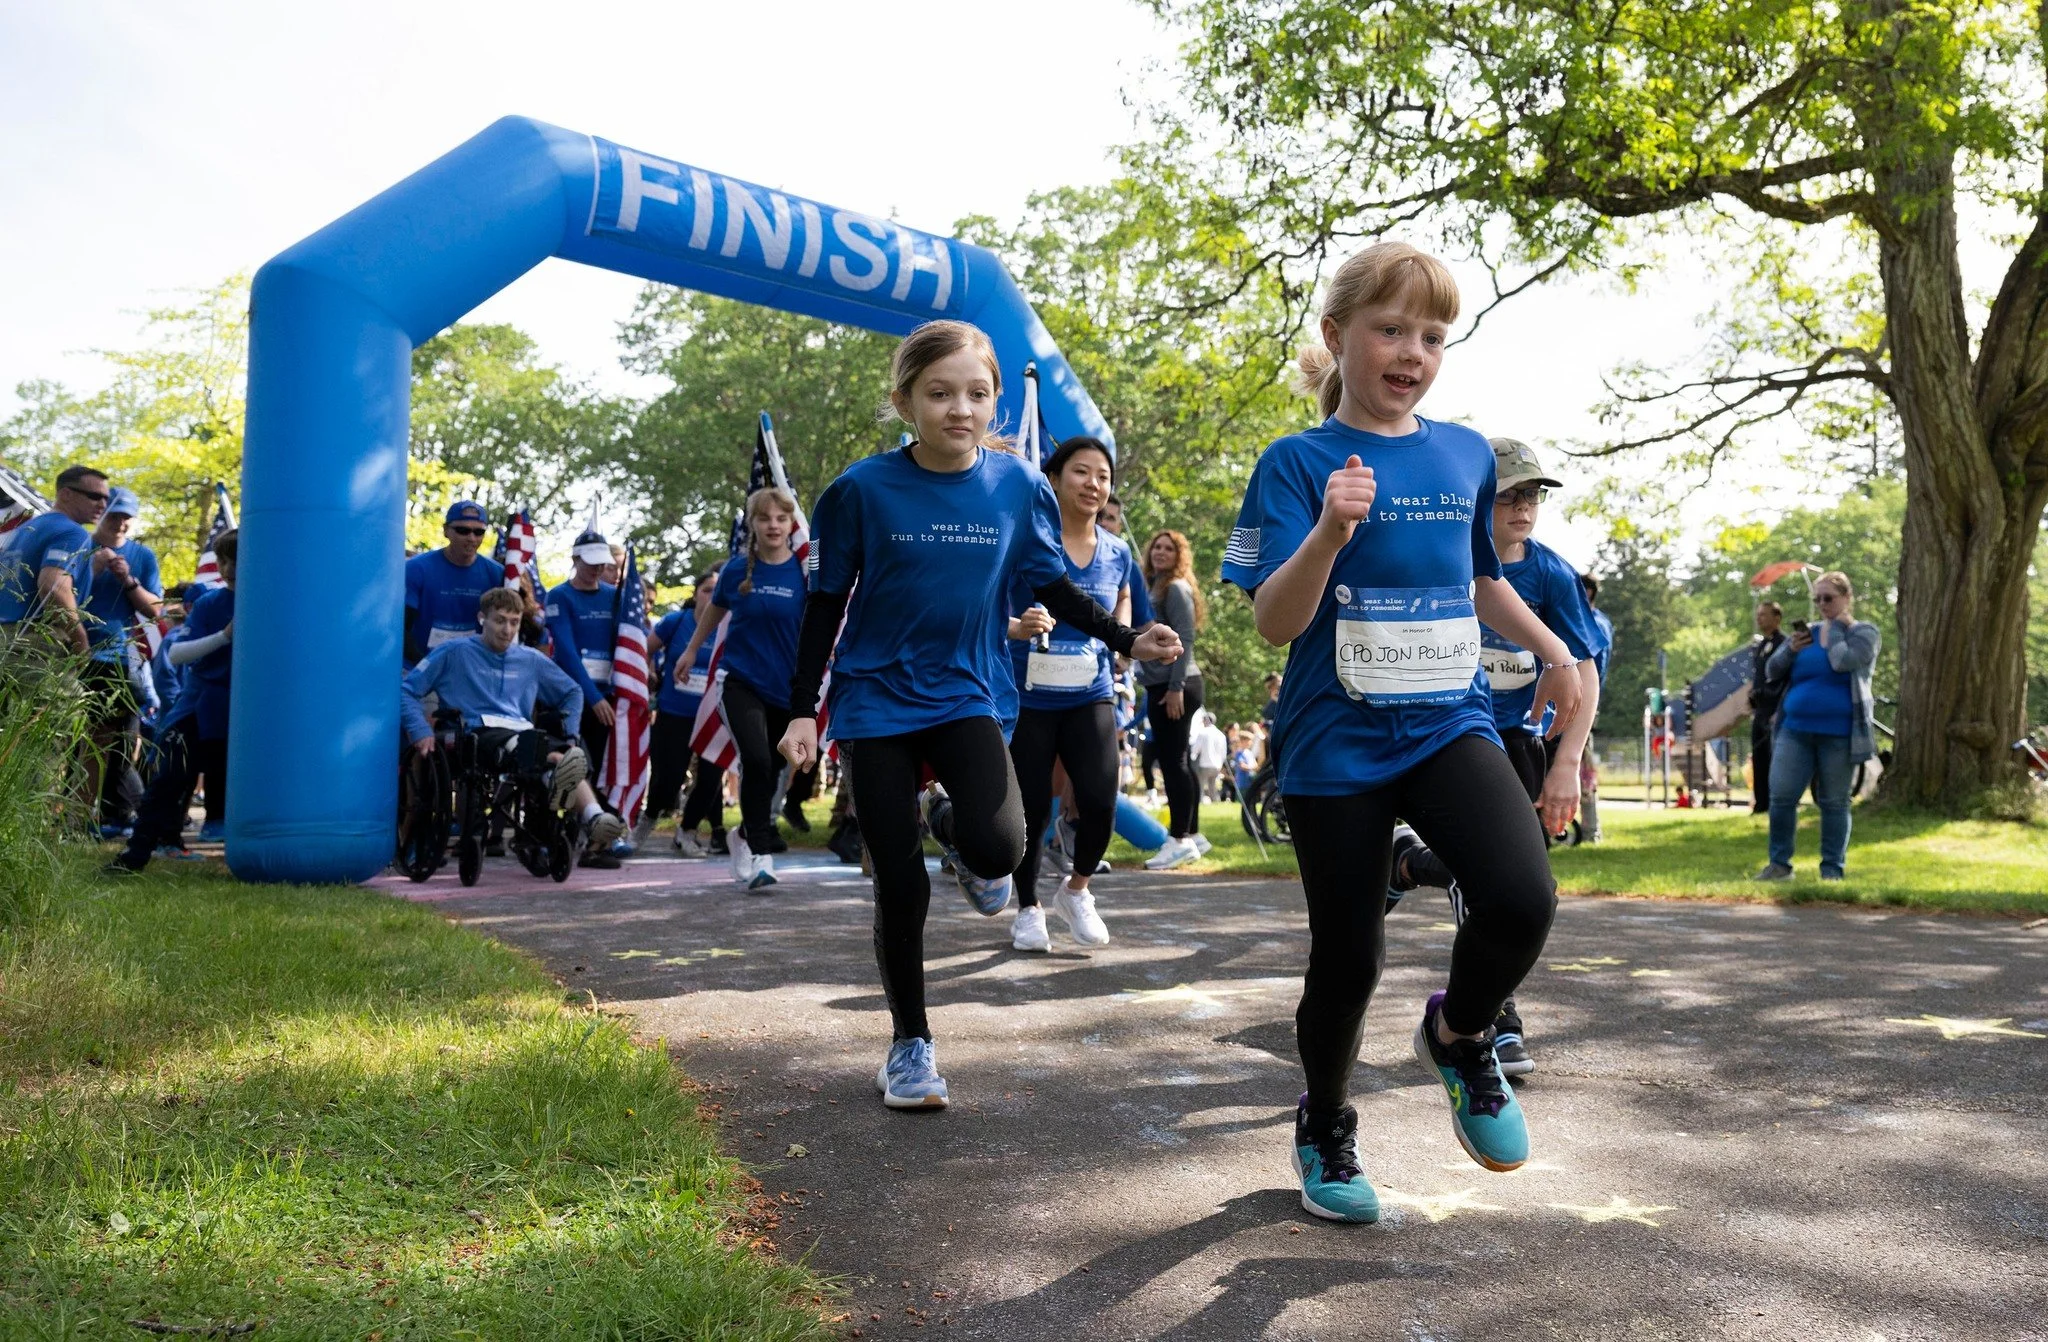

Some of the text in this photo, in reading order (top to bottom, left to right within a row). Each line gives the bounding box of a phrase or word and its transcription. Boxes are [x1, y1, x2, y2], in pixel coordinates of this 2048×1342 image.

[617, 147, 953, 311] FINISH
[1392, 494, 1474, 508] wear blue:
[1380, 510, 1398, 522] to
[1406, 509, 1472, 524] remember
[932, 524, 999, 534] wear blue:
[920, 533, 934, 542] to
[942, 534, 998, 544] remember
[1340, 642, 1477, 663] CPO JON POLLARD
